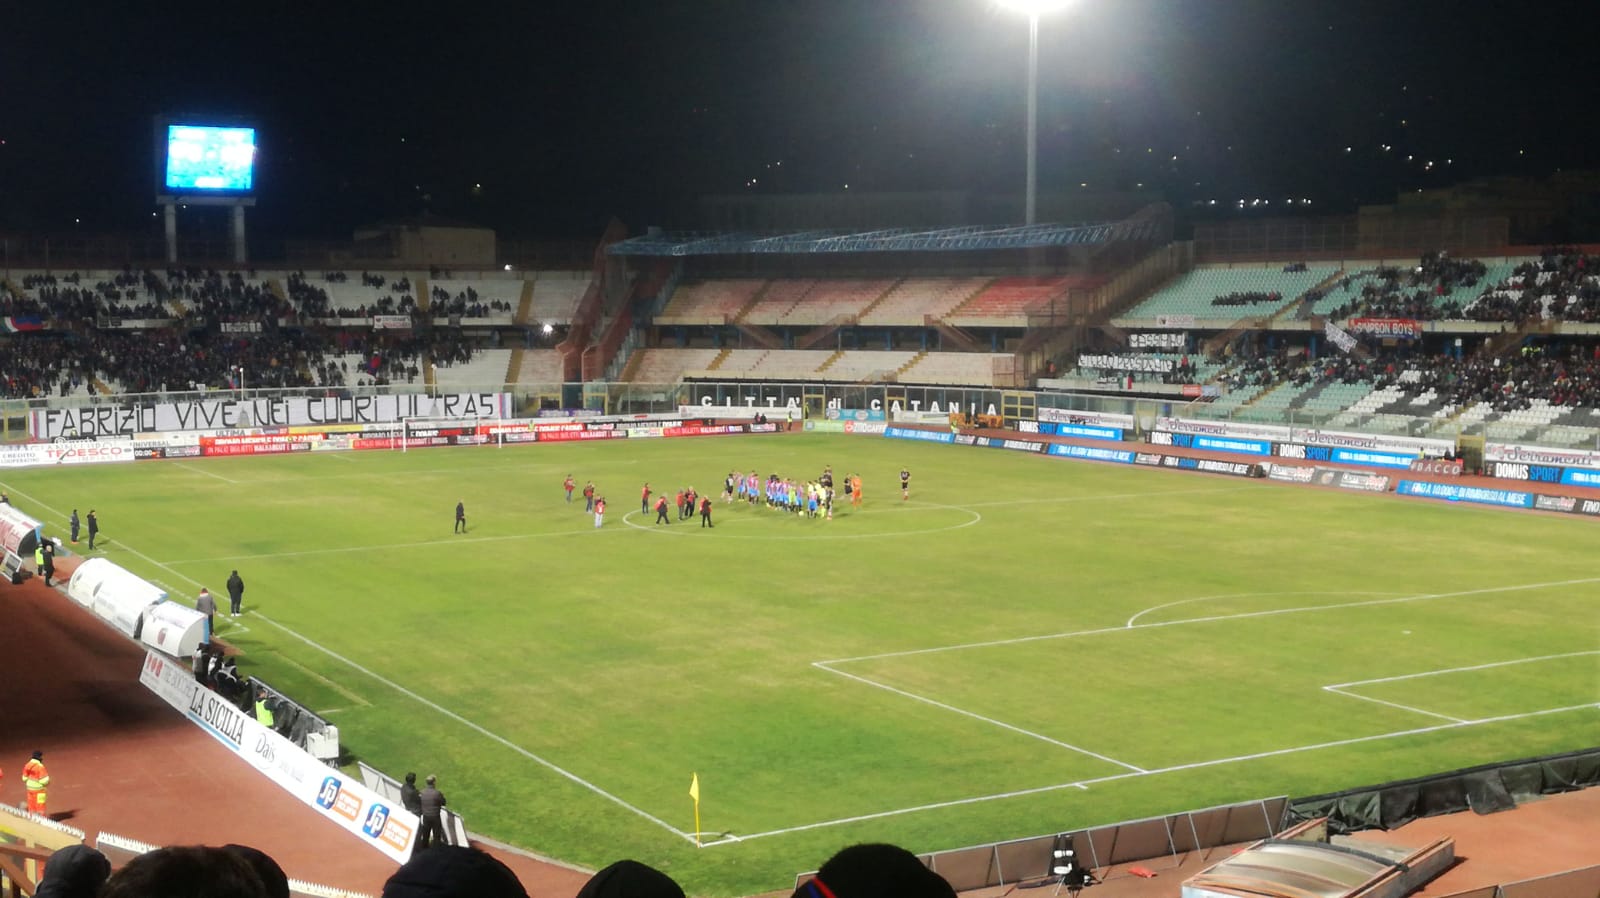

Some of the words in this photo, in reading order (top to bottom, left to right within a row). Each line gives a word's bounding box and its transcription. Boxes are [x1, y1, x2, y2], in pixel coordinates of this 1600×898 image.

[1392, 322, 1414, 335] BOYS
[828, 397, 842, 410] di
[870, 398, 997, 416] CATANIA
[1151, 430, 1173, 446] DOMUS
[46, 447, 122, 458] TEDESCO
[1279, 443, 1306, 459] DOMUS
[1306, 446, 1331, 461] SPORT
[1507, 445, 1594, 466] Serramenti
[1495, 462, 1529, 480] DOMUS
[1529, 464, 1560, 482] SPORT
[189, 686, 204, 717] LA
[205, 697, 245, 745] SICILIA
